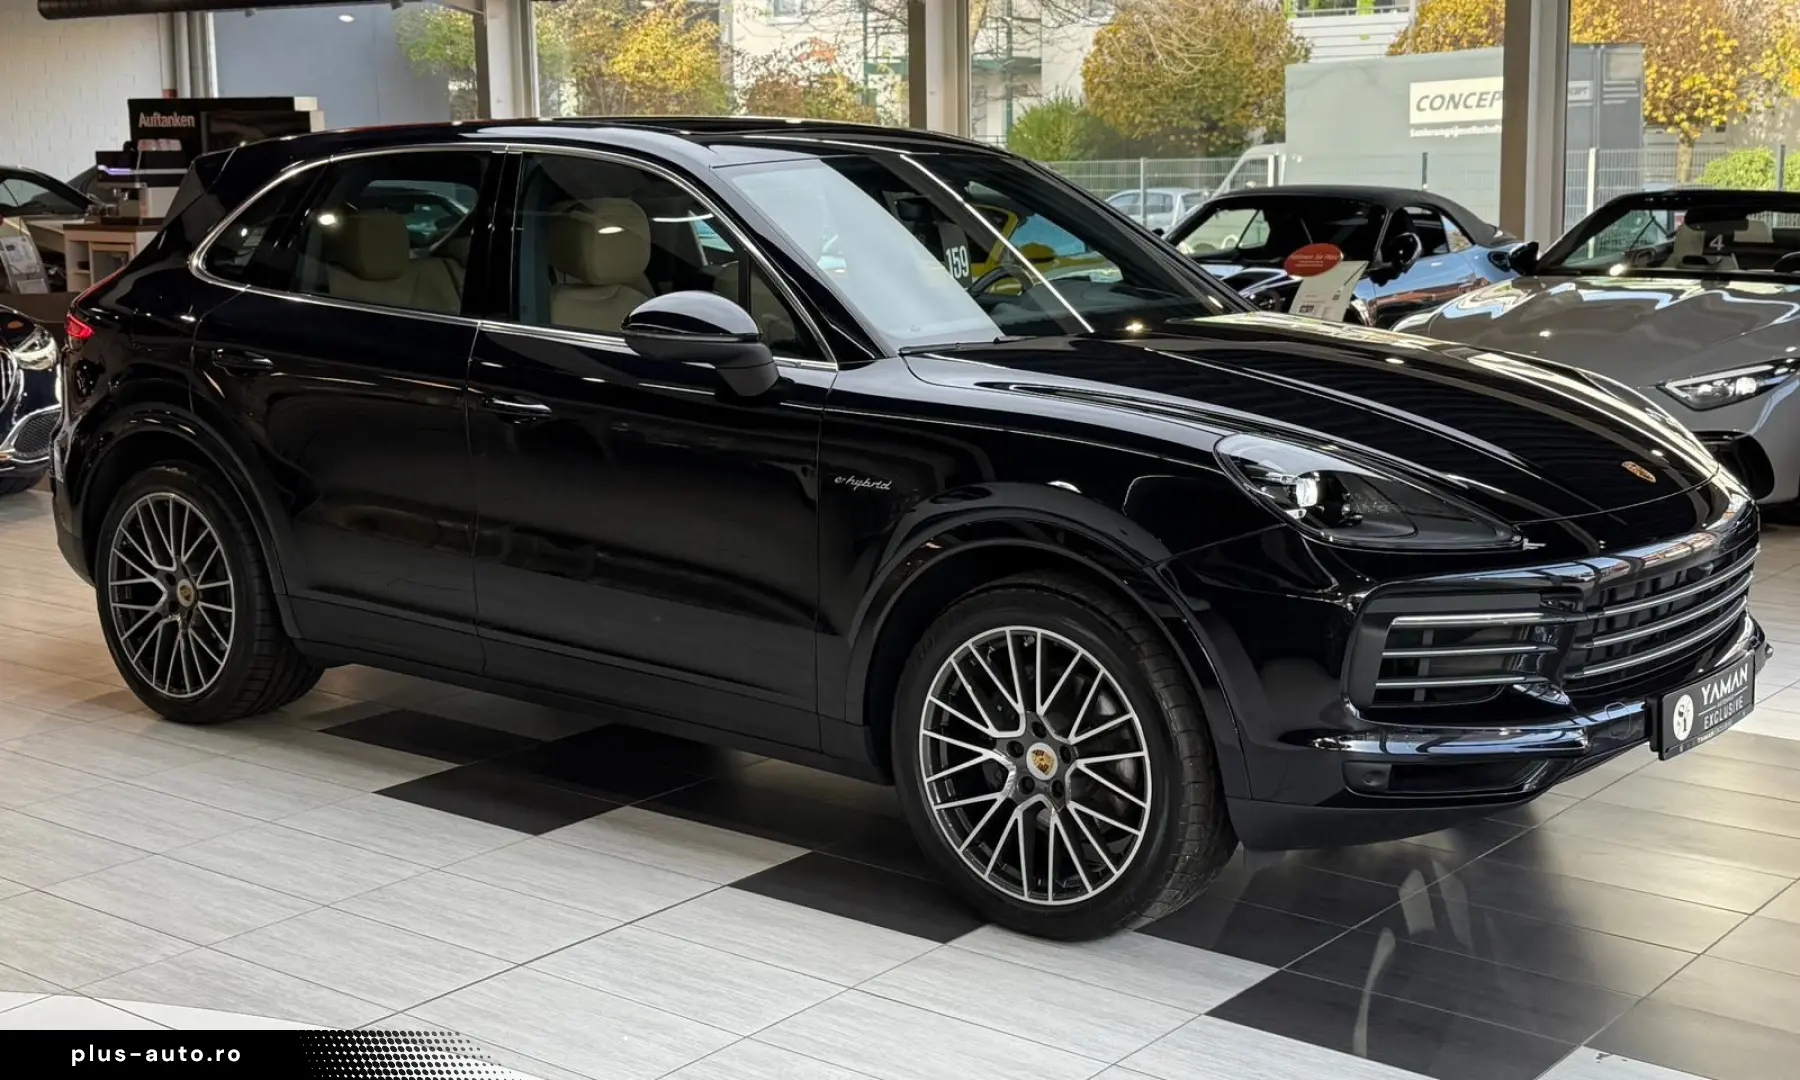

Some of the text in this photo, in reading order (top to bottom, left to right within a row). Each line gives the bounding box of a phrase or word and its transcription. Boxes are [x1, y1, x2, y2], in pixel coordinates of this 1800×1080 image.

[1416, 91, 1502, 112] CONCEP
[139, 111, 196, 128] Auftanken
[1709, 234, 1724, 251] 4
[946, 245, 970, 279] 159
[1701, 663, 1748, 705] YAMAN
